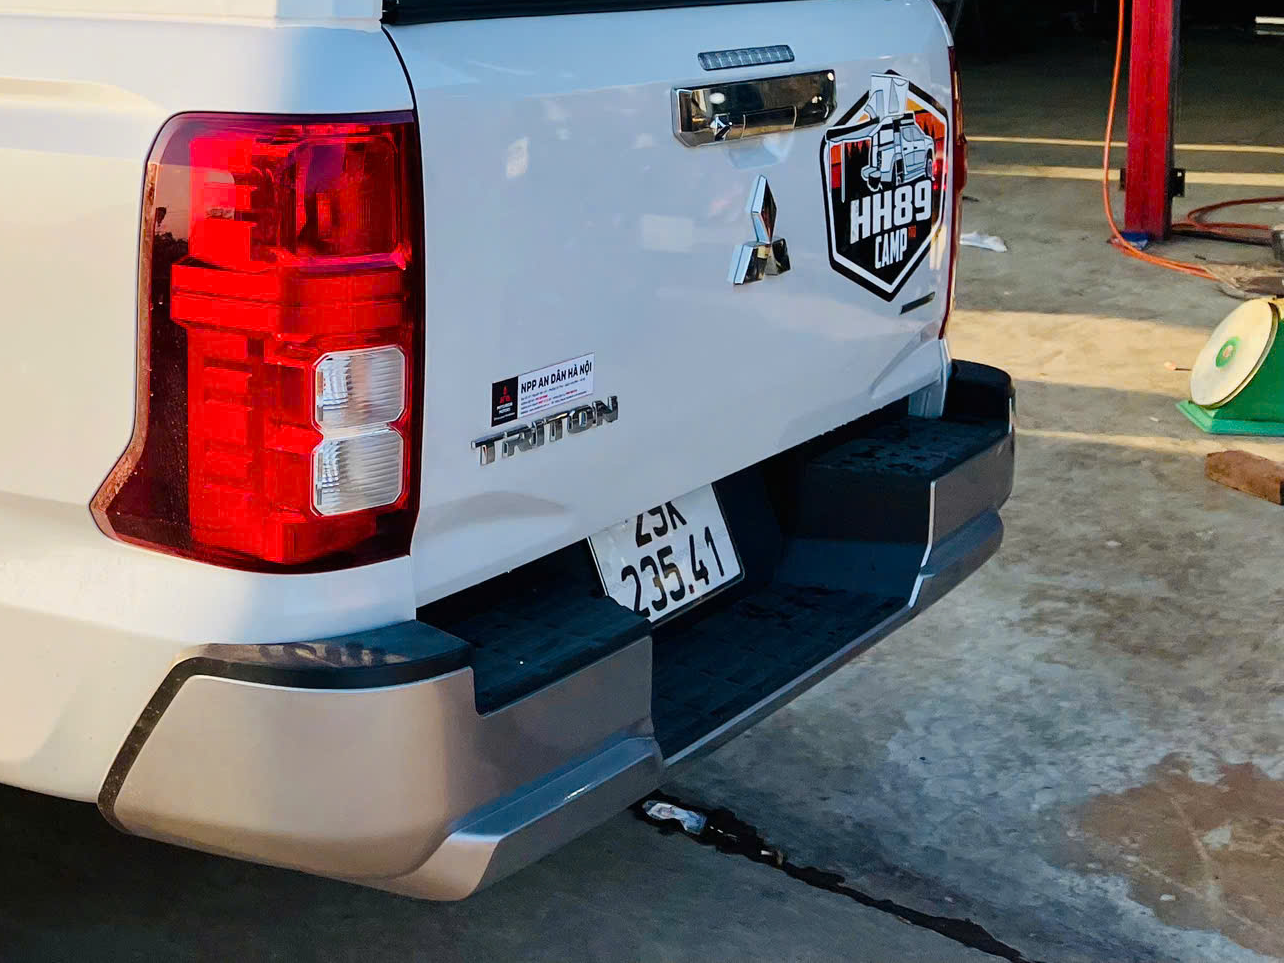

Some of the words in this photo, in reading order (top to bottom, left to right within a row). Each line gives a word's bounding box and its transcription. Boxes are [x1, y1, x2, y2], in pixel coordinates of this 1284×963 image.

[850, 179, 933, 245] HH89
[874, 227, 908, 269] CAMP
[520, 379, 537, 394] NPP
[538, 375, 550, 388] AN
[550, 369, 567, 384] DÂN
[567, 364, 579, 378] HÀ
[579, 359, 592, 376] NỘI
[471, 395, 619, 466] TRITON
[621, 526, 725, 618] 235.41
